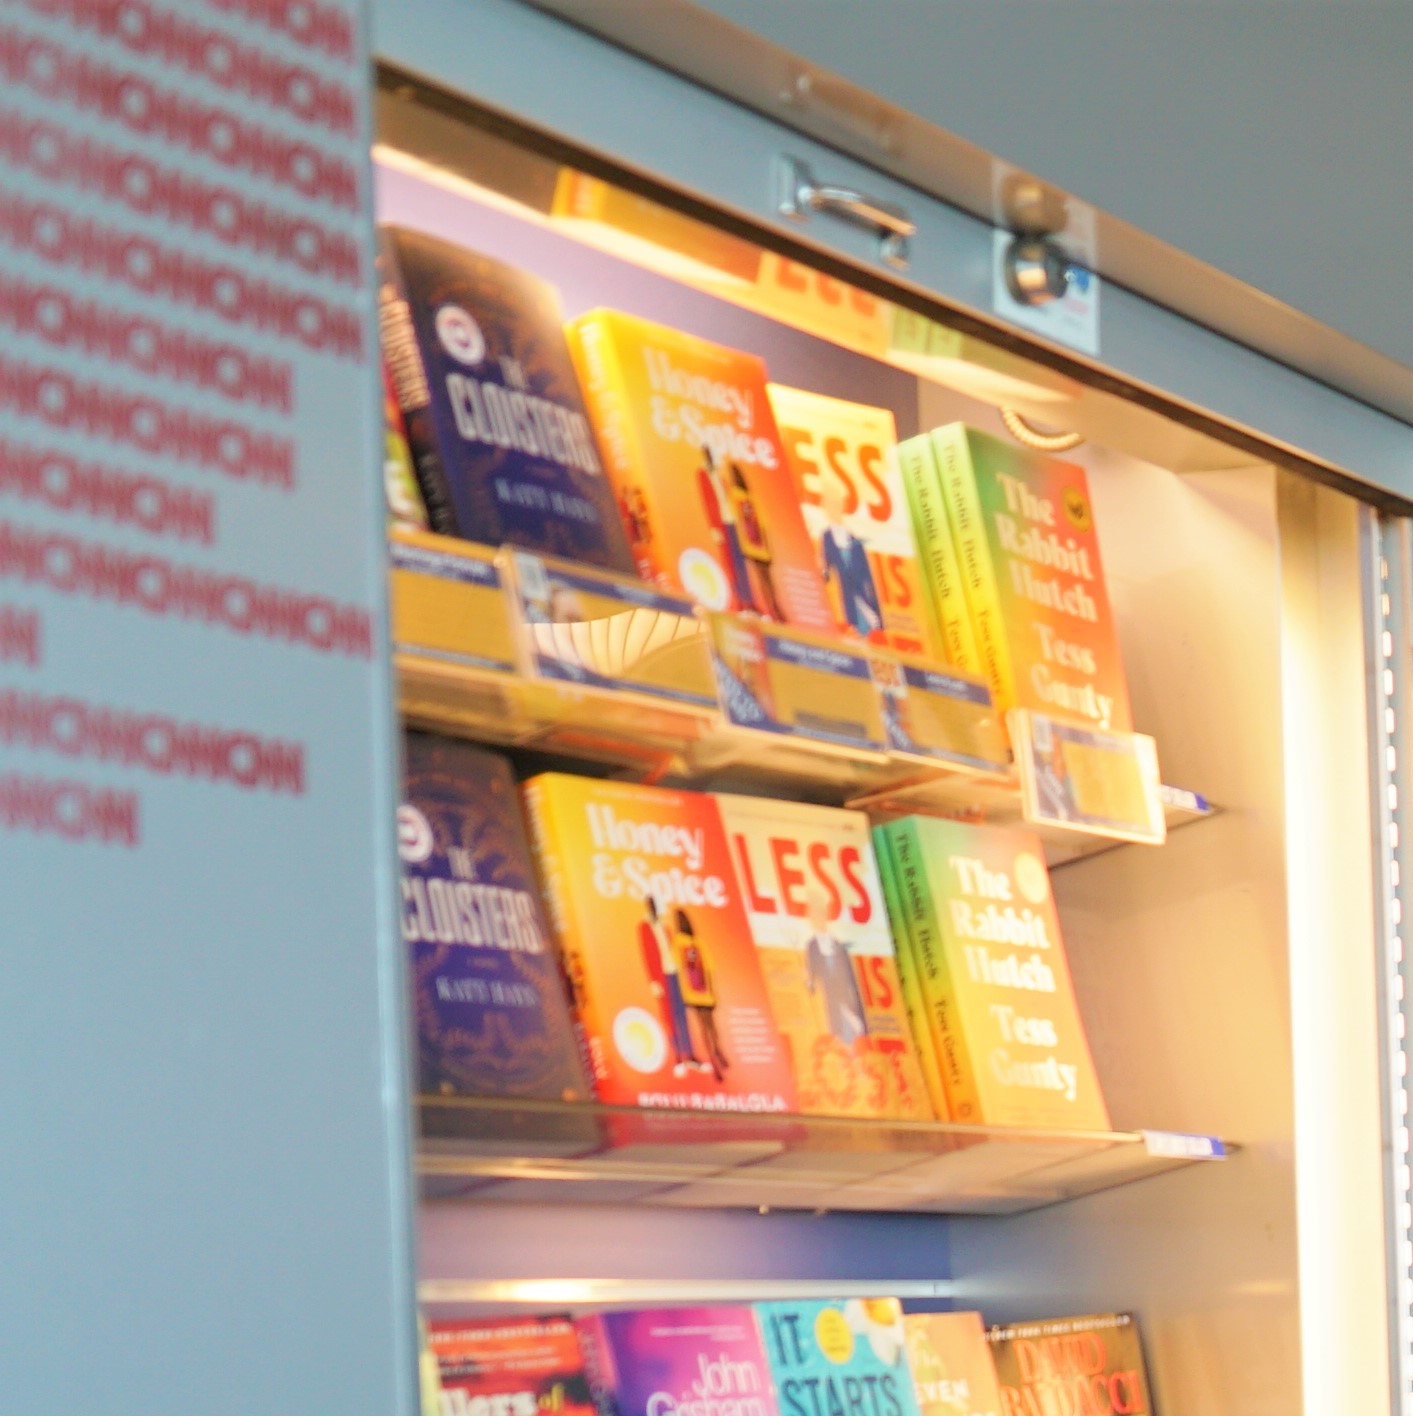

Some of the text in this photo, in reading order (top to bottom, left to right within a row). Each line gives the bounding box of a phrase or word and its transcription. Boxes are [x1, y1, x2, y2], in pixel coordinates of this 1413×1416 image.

[643, 345, 755, 428] Honey
[998, 472, 1055, 525] The
[997, 512, 1093, 579] Rabbit
[1008, 567, 1098, 624] Hutch
[1031, 622, 1097, 675] Tess
[1031, 662, 1114, 730] Gunty
[584, 802, 704, 868] Honey
[733, 832, 872, 924] LESS
[950, 856, 1012, 901] The
[953, 898, 1052, 951] Rabbit
[965, 945, 1056, 995] Hutch
[996, 1007, 1056, 1050] Tess
[991, 1043, 1077, 1101] Gunty
[770, 1313, 807, 1368] IT
[1013, 1332, 1107, 1380] DAVID
[693, 1353, 761, 1398] John
